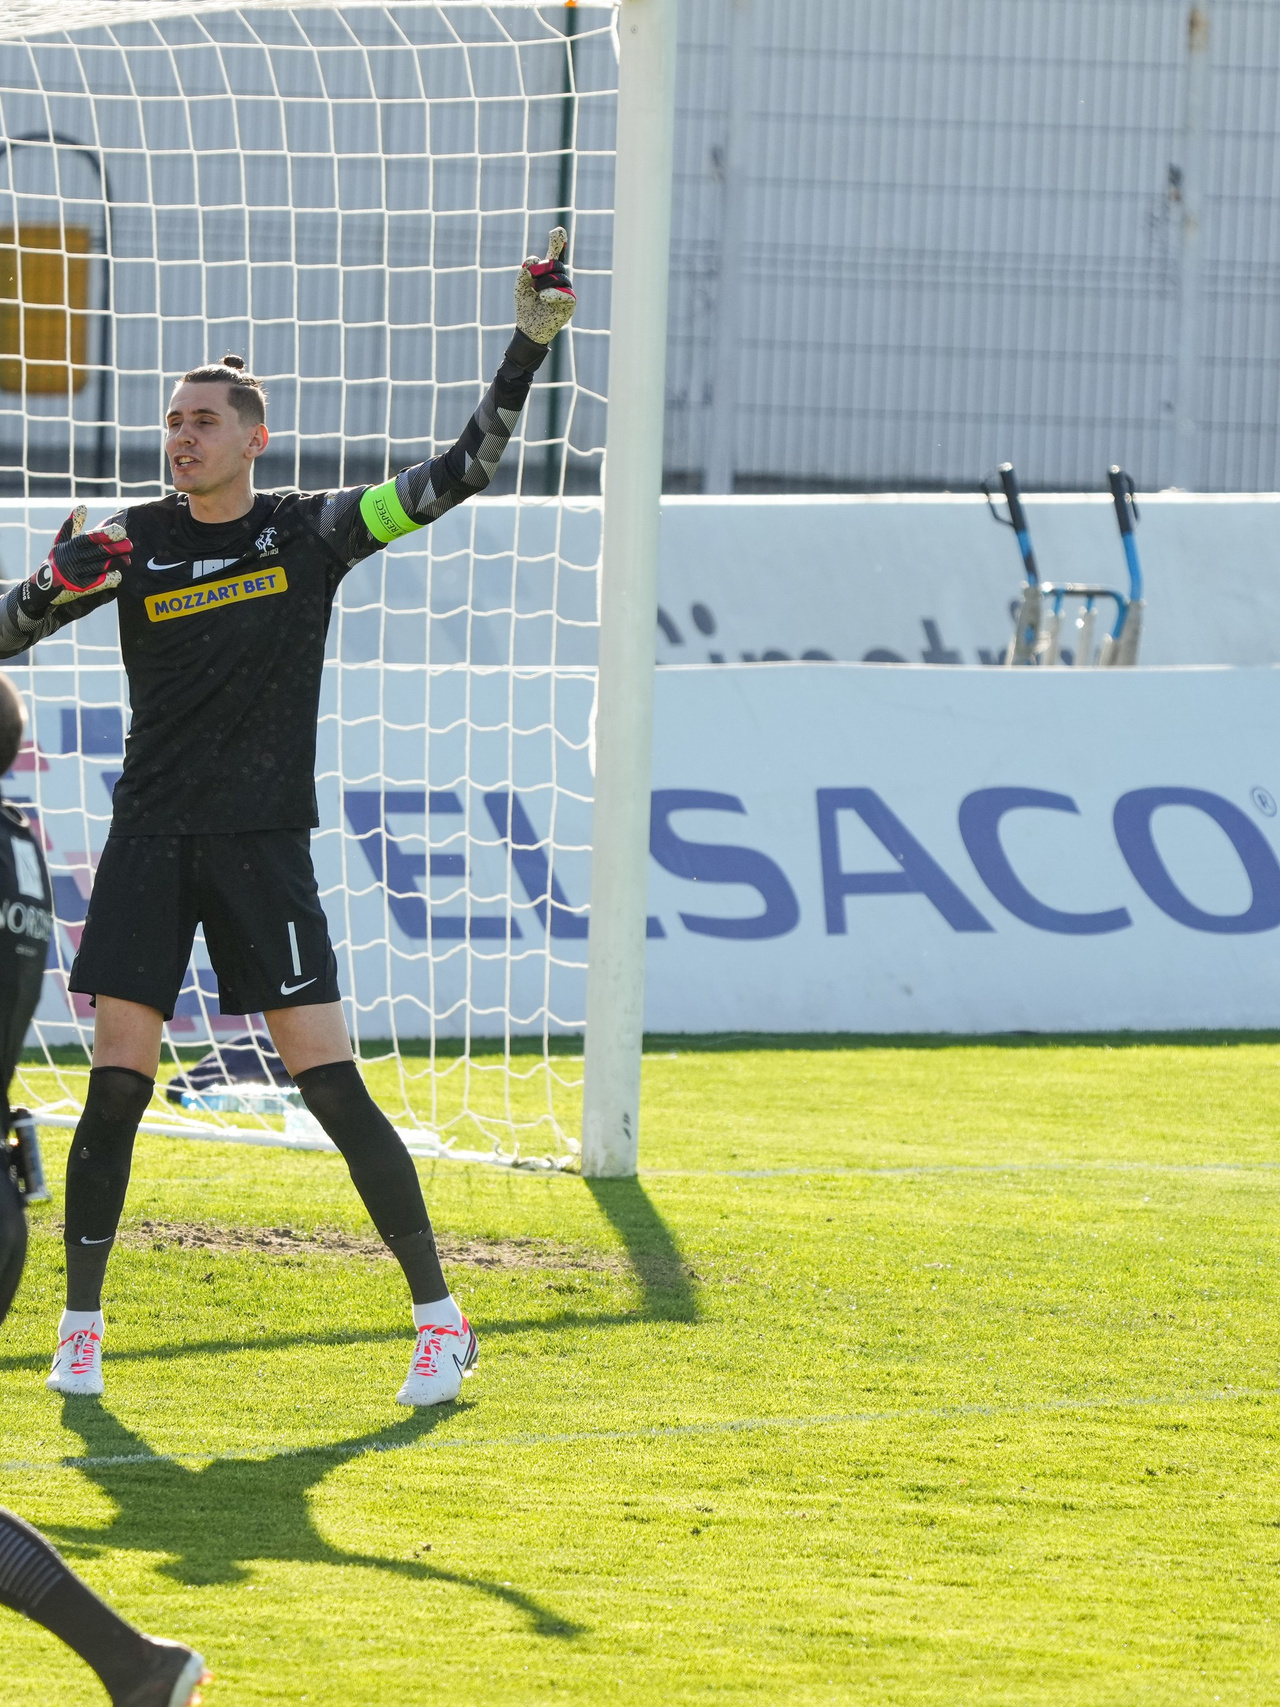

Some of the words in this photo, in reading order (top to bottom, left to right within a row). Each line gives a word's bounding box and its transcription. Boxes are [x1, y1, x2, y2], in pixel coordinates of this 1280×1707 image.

[375, 499, 399, 534] RESPECT
[154, 583, 239, 616] MOZZART
[243, 574, 276, 593] BET
[341, 786, 1280, 940] ELSACO
